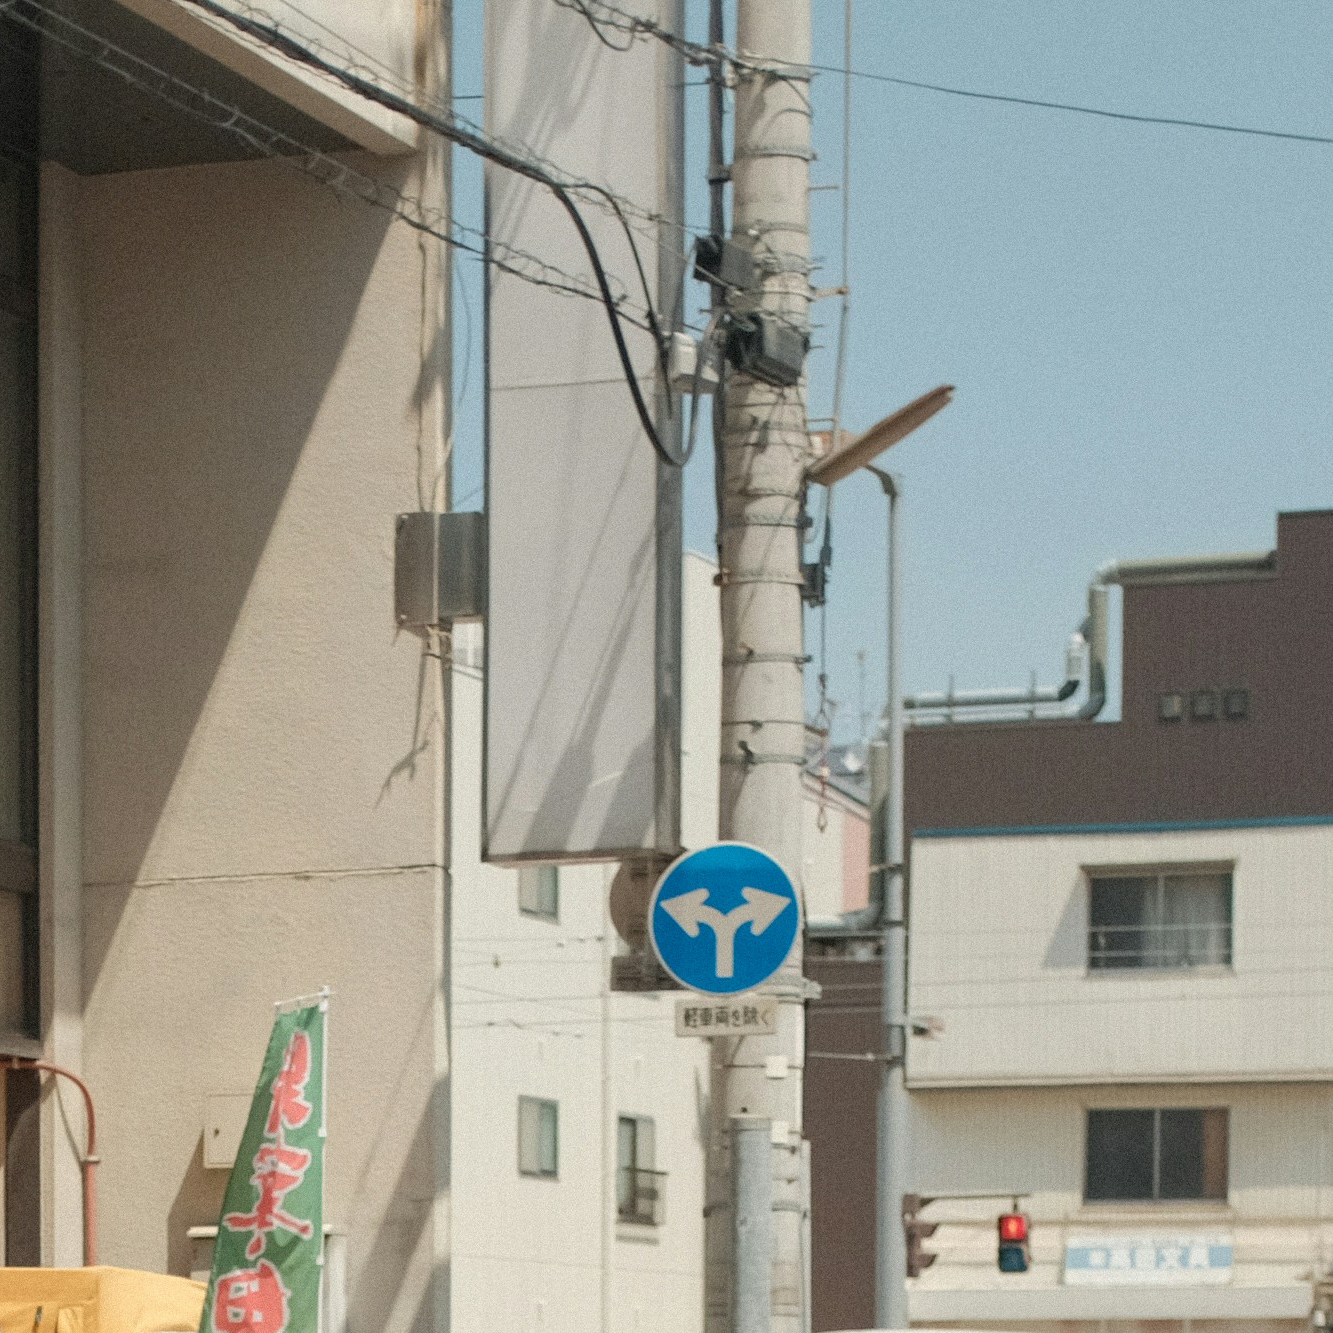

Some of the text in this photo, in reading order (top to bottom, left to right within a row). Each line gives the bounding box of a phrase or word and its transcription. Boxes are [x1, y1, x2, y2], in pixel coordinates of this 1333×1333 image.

[683, 1005, 770, 1029] 軽車両を除く
